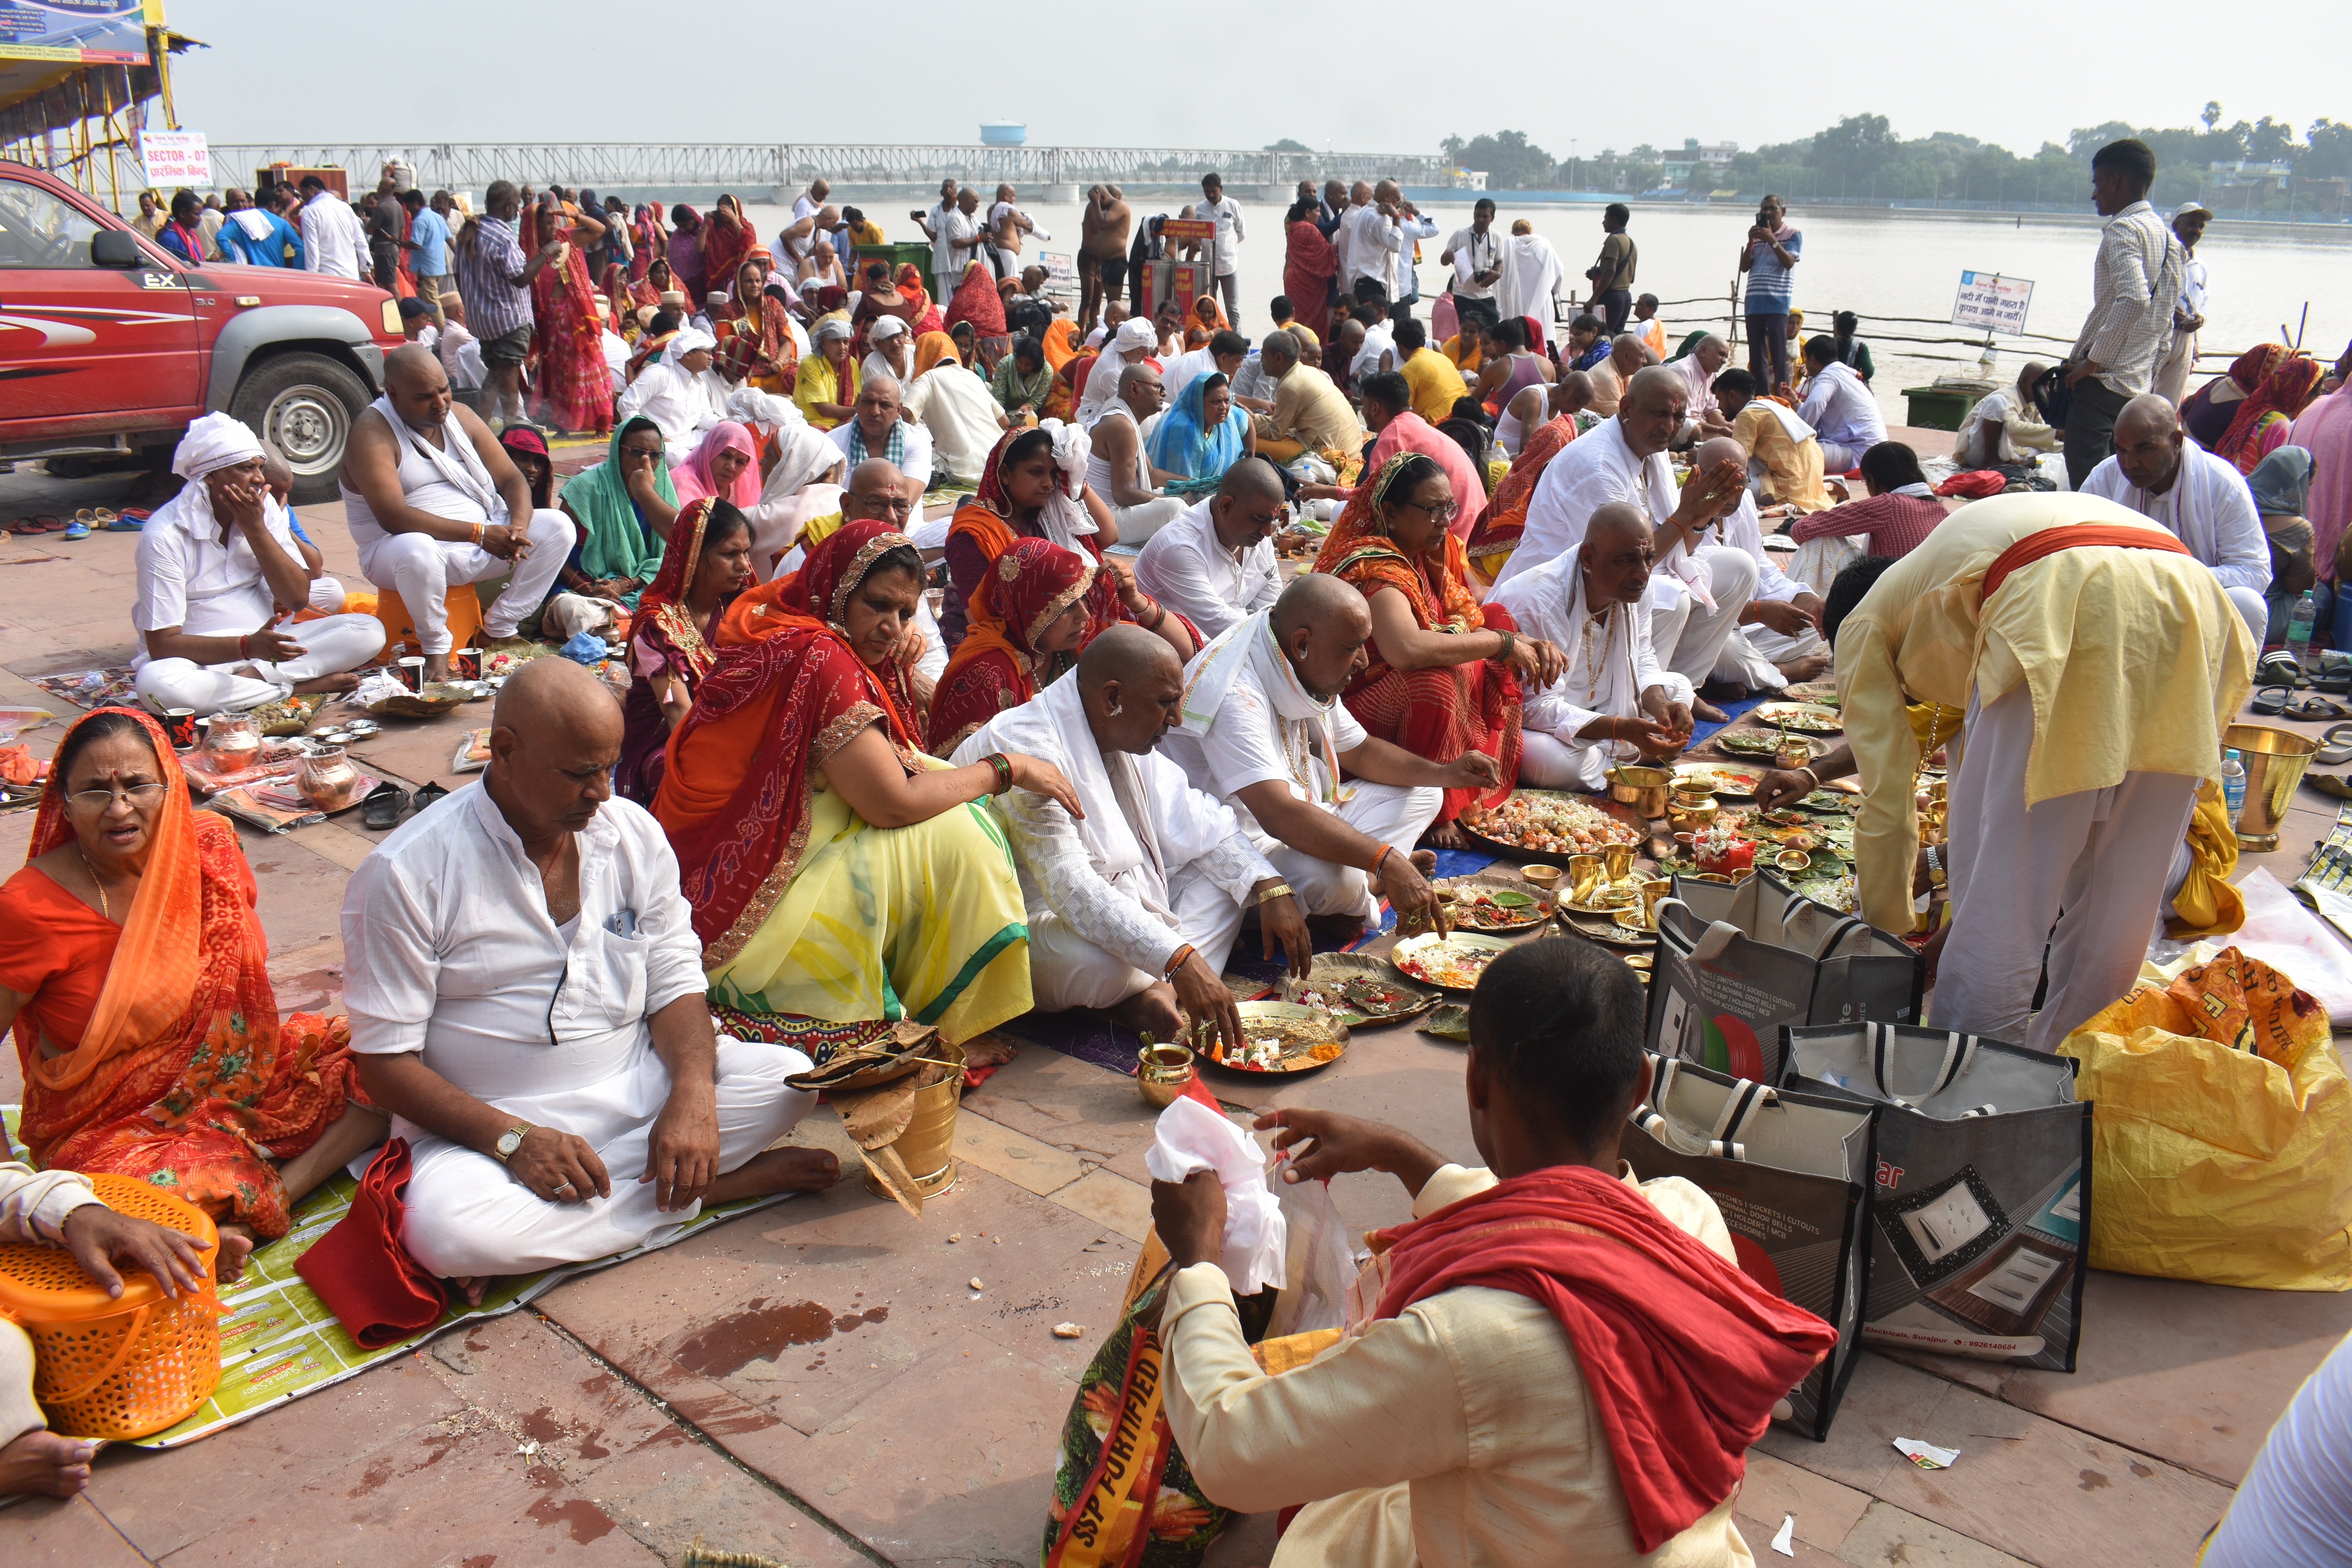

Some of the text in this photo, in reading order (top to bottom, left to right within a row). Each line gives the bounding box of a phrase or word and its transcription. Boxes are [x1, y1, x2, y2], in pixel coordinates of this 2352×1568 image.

[148, 151, 185, 162] SECTOR
[194, 151, 206, 161] 07
[150, 164, 209, 178] प्रारंभिक बिन्दु
[144, 273, 176, 283] EX
[195, 298, 216, 306] 3.0
[1960, 291, 2025, 310] नदी में पानी गहरा है
[1958, 303, 1979, 314] कृपया
[1980, 307, 1995, 317] आगे
[1996, 310, 2003, 318] न
[1723, 968, 1745, 981] QUALITY
[1717, 975, 1742, 989] SWITCHES
[1746, 986, 1768, 999] SOCKETS
[1773, 996, 1796, 1010] CUTOUTS
[1722, 985, 1743, 998] NORMAL
[1745, 994, 1760, 1003] DOOR
[1760, 1000, 1776, 1010] BELLS
[1706, 996, 1720, 1006] OTHER
[1721, 1003, 1755, 1019] ACCESSORIES
[1713, 991, 1728, 1000] STRIP
[1731, 998, 1755, 1011] HOLDERS
[1759, 1007, 1770, 1017] MCB
[2268, 994, 2295, 1051] PREMIUM
[1708, 1190, 1742, 1206] SWITCHES
[1749, 1203, 1781, 1218] SOCKETS
[1788, 1216, 1820, 1234] CUTOUTS
[1719, 1199, 1748, 1214] NORMAL
[1750, 1210, 1769, 1222] DOOR
[1772, 1219, 1792, 1232] BELLS
[1734, 1212, 1765, 1229] HOLDERS
[1771, 1227, 1786, 1239] MCB
[220, 1323, 251, 1338] ALMOND
[240, 1325, 264, 1338] Sweet
[1865, 1327, 1910, 1339] Electricals,
[1912, 1333, 1948, 1344] Surajpur
[1968, 1341, 2017, 1350] 9926140684
[255, 1364, 285, 1381] ALMOND
[276, 1365, 301, 1381] Sweet
[243, 1381, 268, 1396] Salty
[1072, 1493, 1104, 1548] SSP
[1098, 1358, 1159, 1498] FORTIFIED
